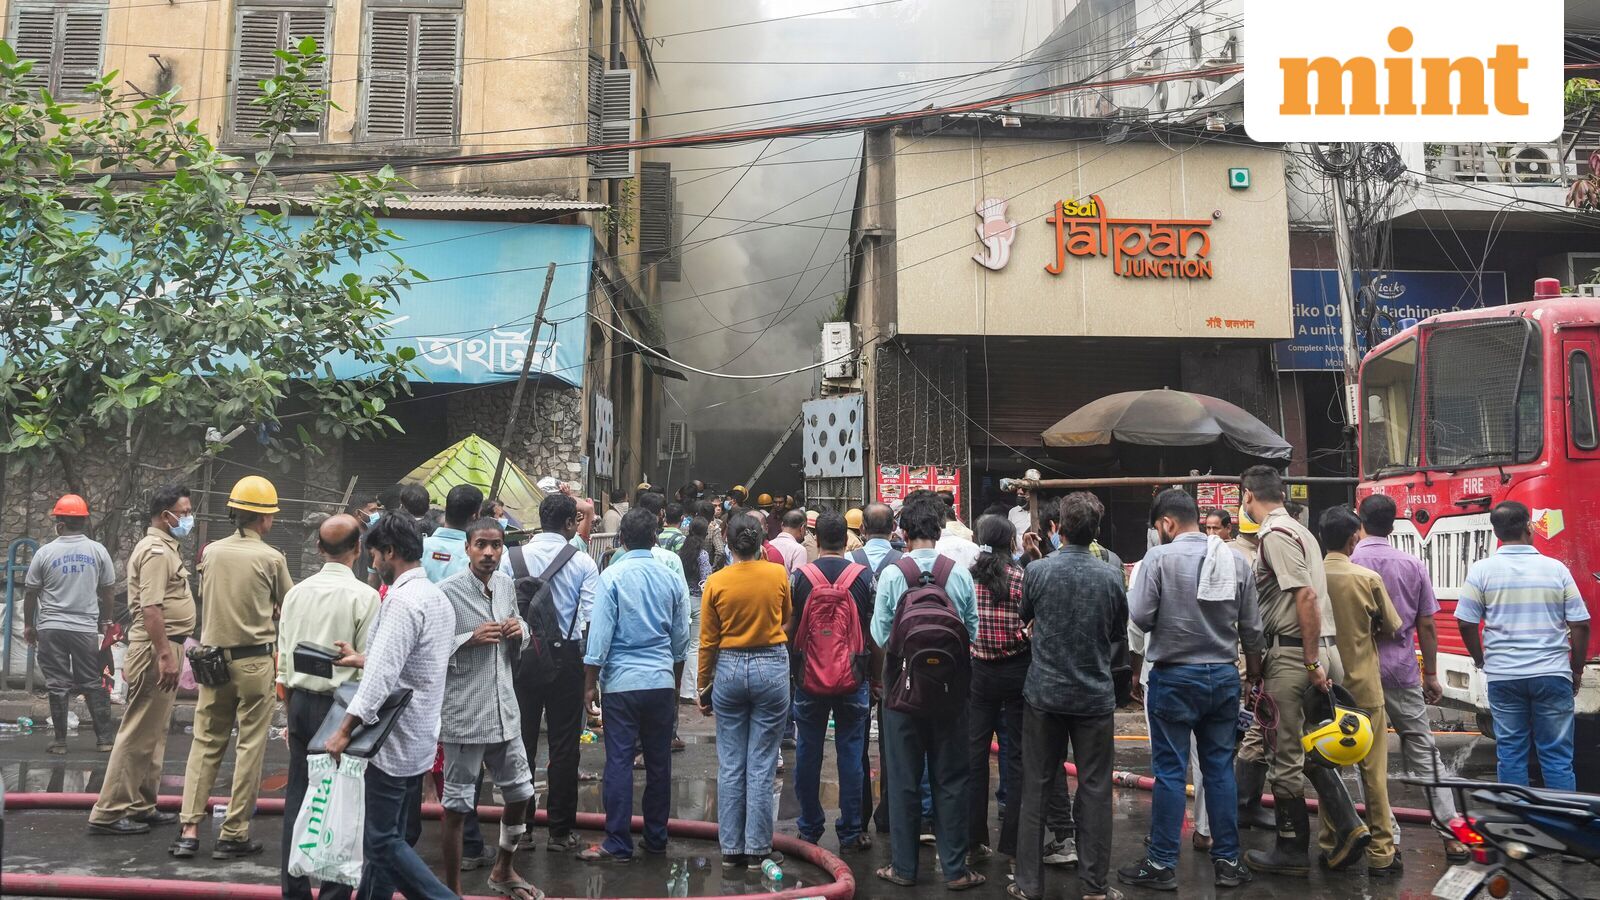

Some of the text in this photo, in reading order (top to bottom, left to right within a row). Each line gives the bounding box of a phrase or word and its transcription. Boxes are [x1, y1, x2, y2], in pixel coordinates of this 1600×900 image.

[1123, 258, 1213, 279] JUNCTION
[1298, 324, 1308, 335] A
[1310, 324, 1337, 335] unit
[1287, 344, 1324, 353] Complete
[1463, 477, 1484, 494] FIRE
[1423, 494, 1437, 503] LTD
